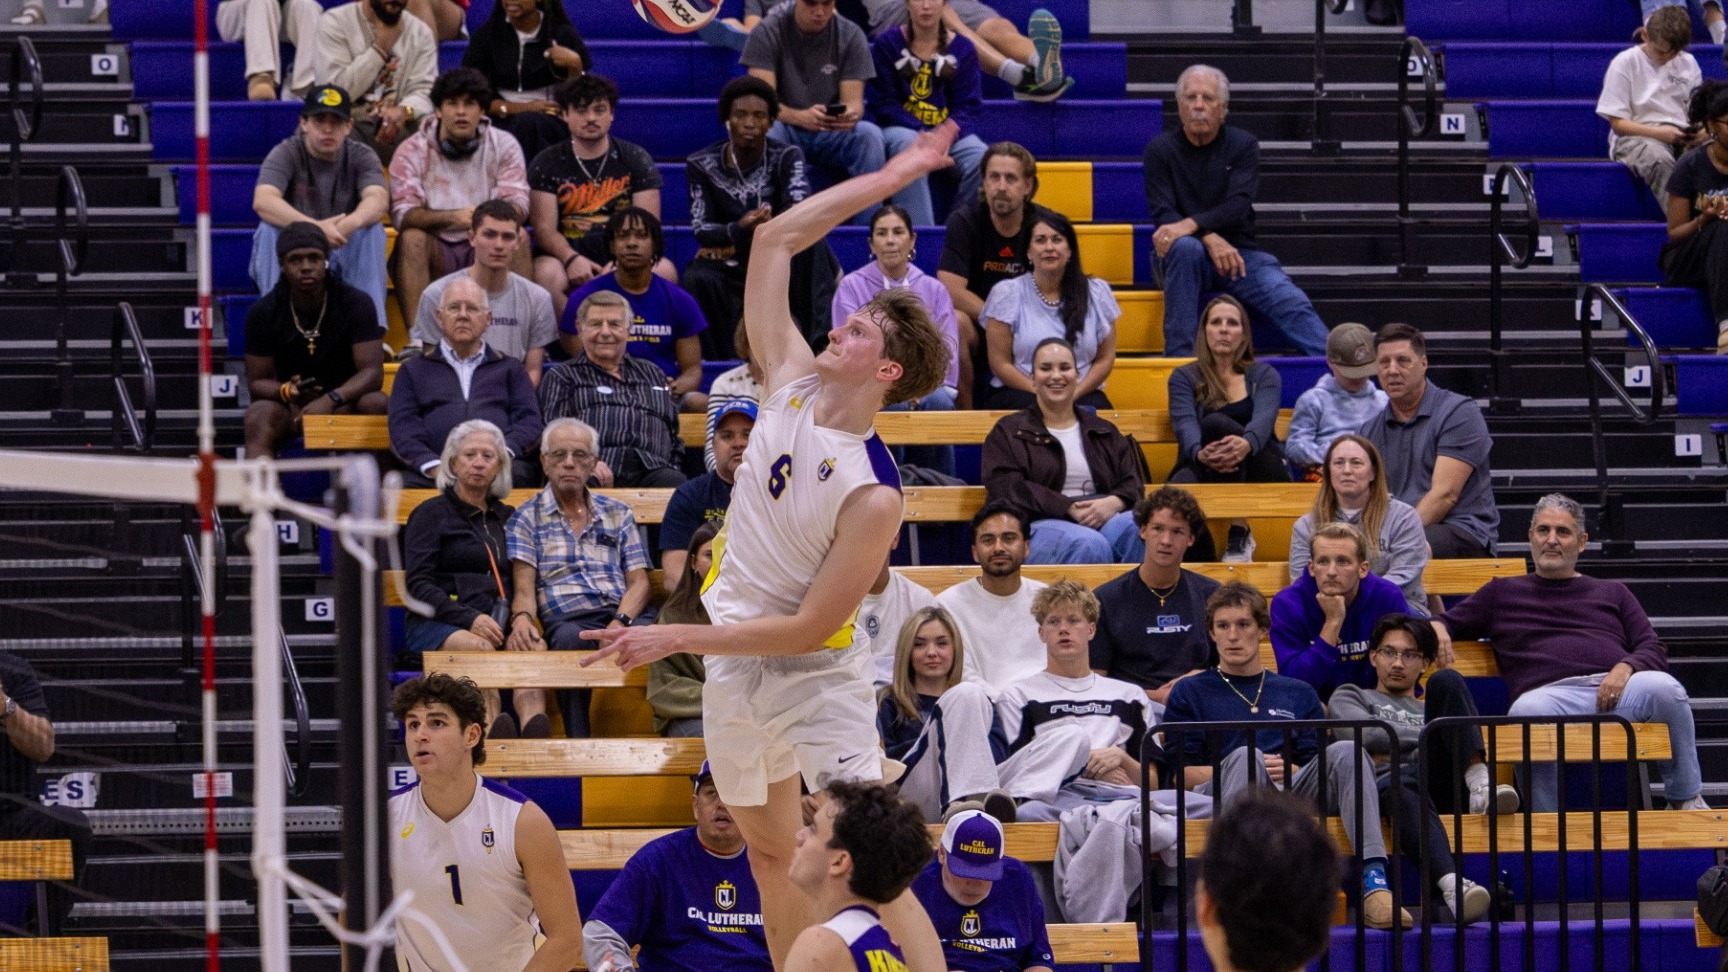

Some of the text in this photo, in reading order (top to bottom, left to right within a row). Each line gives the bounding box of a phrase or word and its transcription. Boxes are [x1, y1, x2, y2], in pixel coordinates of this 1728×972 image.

[98, 58, 112, 72] O
[1447, 117, 1459, 131] N
[557, 176, 631, 215] Miller
[983, 261, 1026, 273] PROAC
[629, 324, 672, 335] UTHERAN
[1632, 369, 1644, 383] J
[219, 379, 231, 393] J
[767, 453, 793, 502] 6
[277, 524, 292, 540] H
[313, 601, 329, 618] G
[1146, 624, 1192, 634] RUSTY
[394, 770, 408, 787] E
[960, 843, 994, 854] LUTHERAN
[444, 864, 464, 906] 1
